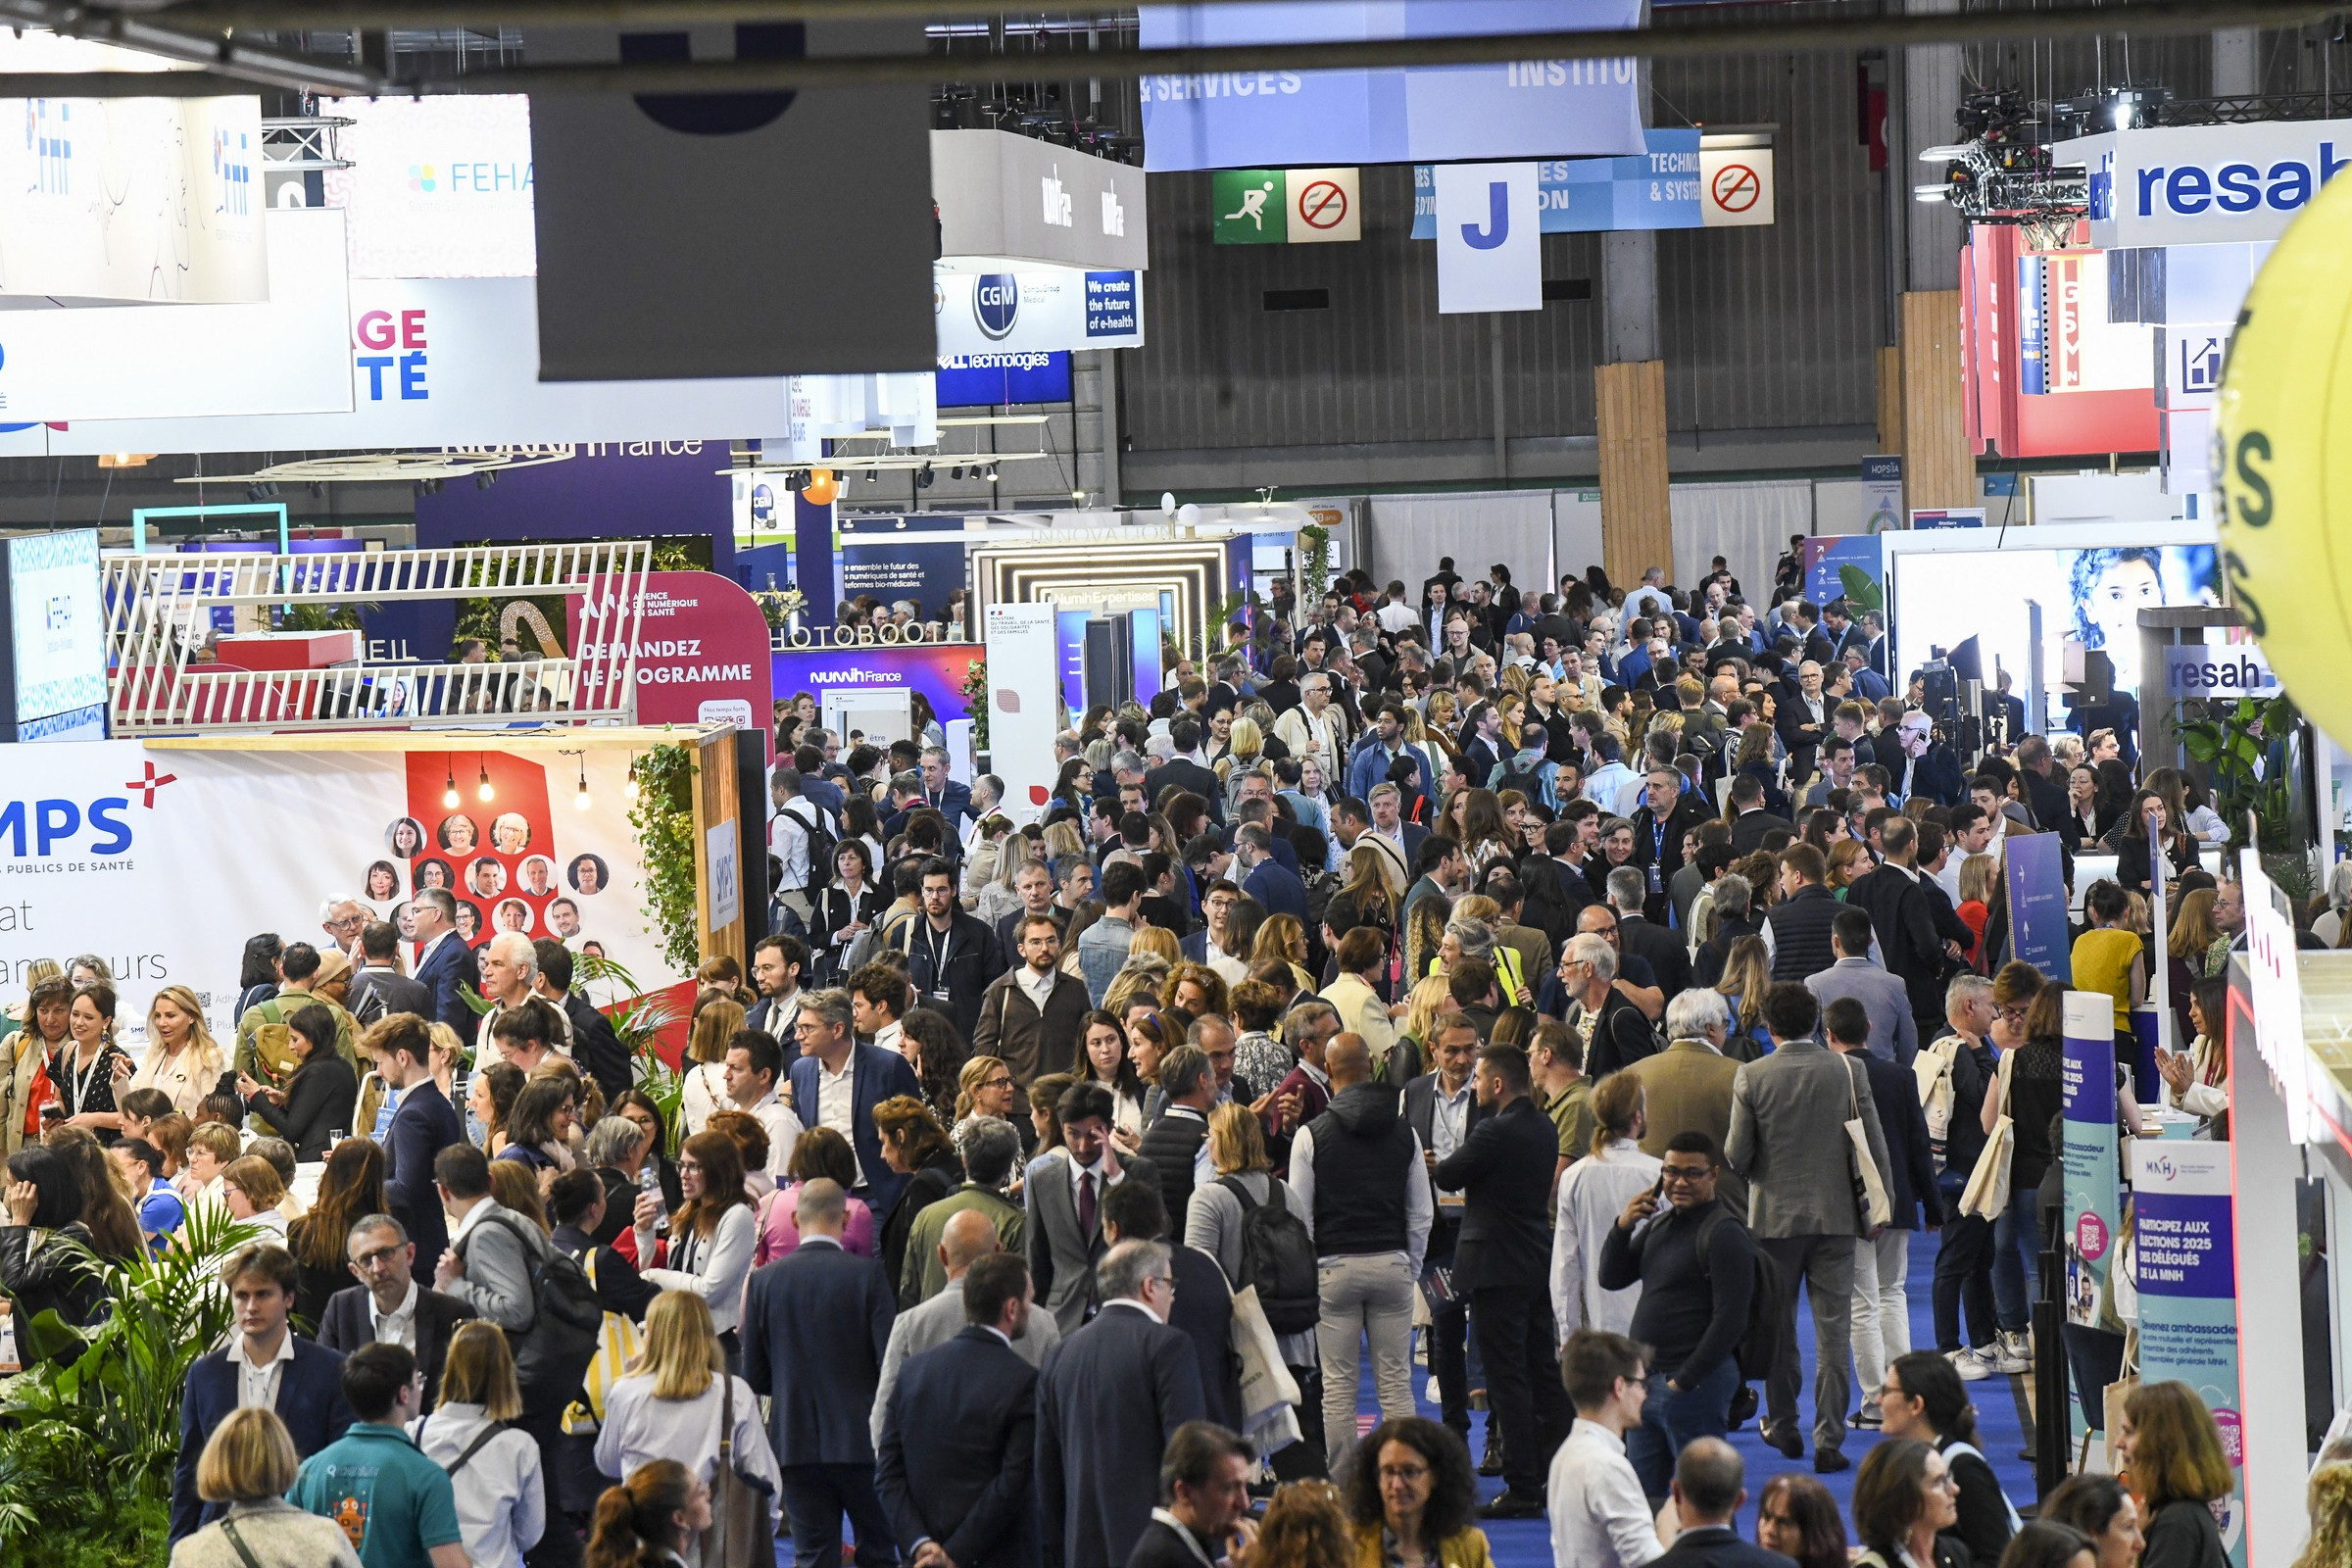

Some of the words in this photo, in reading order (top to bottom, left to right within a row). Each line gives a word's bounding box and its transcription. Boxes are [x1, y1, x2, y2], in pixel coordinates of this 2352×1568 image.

[1157, 71, 1302, 102] SERVICES
[1539, 162, 1568, 182] ES
[1650, 181, 1661, 202] &
[1461, 181, 1508, 250] J
[1088, 280, 1102, 293] We
[1103, 280, 1130, 292] create
[980, 285, 1014, 307] CGM
[1089, 298, 1103, 312] the
[1104, 297, 1131, 312] future
[353, 310, 427, 350] GE
[1090, 317, 1100, 330] of
[1101, 315, 1134, 329] e-health
[850, 563, 882, 571] ensemble
[890, 562, 906, 570] futur
[850, 571, 888, 580] numériques
[647, 598, 699, 609] NUMÉRIQUE
[647, 607, 675, 617] SANTÉ
[363, 639, 419, 662] EIL
[613, 663, 753, 685] POGRAMME
[2171, 654, 2260, 688] resah
[869, 733, 886, 743] être
[7, 862, 64, 874] PUBLICS
[69, 861, 85, 872] DE
[90, 858, 135, 872] SANTÉ
[2138, 1218, 2182, 1233] PARTICIPEZ
[2183, 1221, 2210, 1234] AUX
[2181, 1238, 2213, 1250] 2025
[2151, 1250, 2200, 1267] DÉLÉGUÉS
[2148, 1268, 2159, 1281] LA
[2159, 1268, 2184, 1282] MNH
